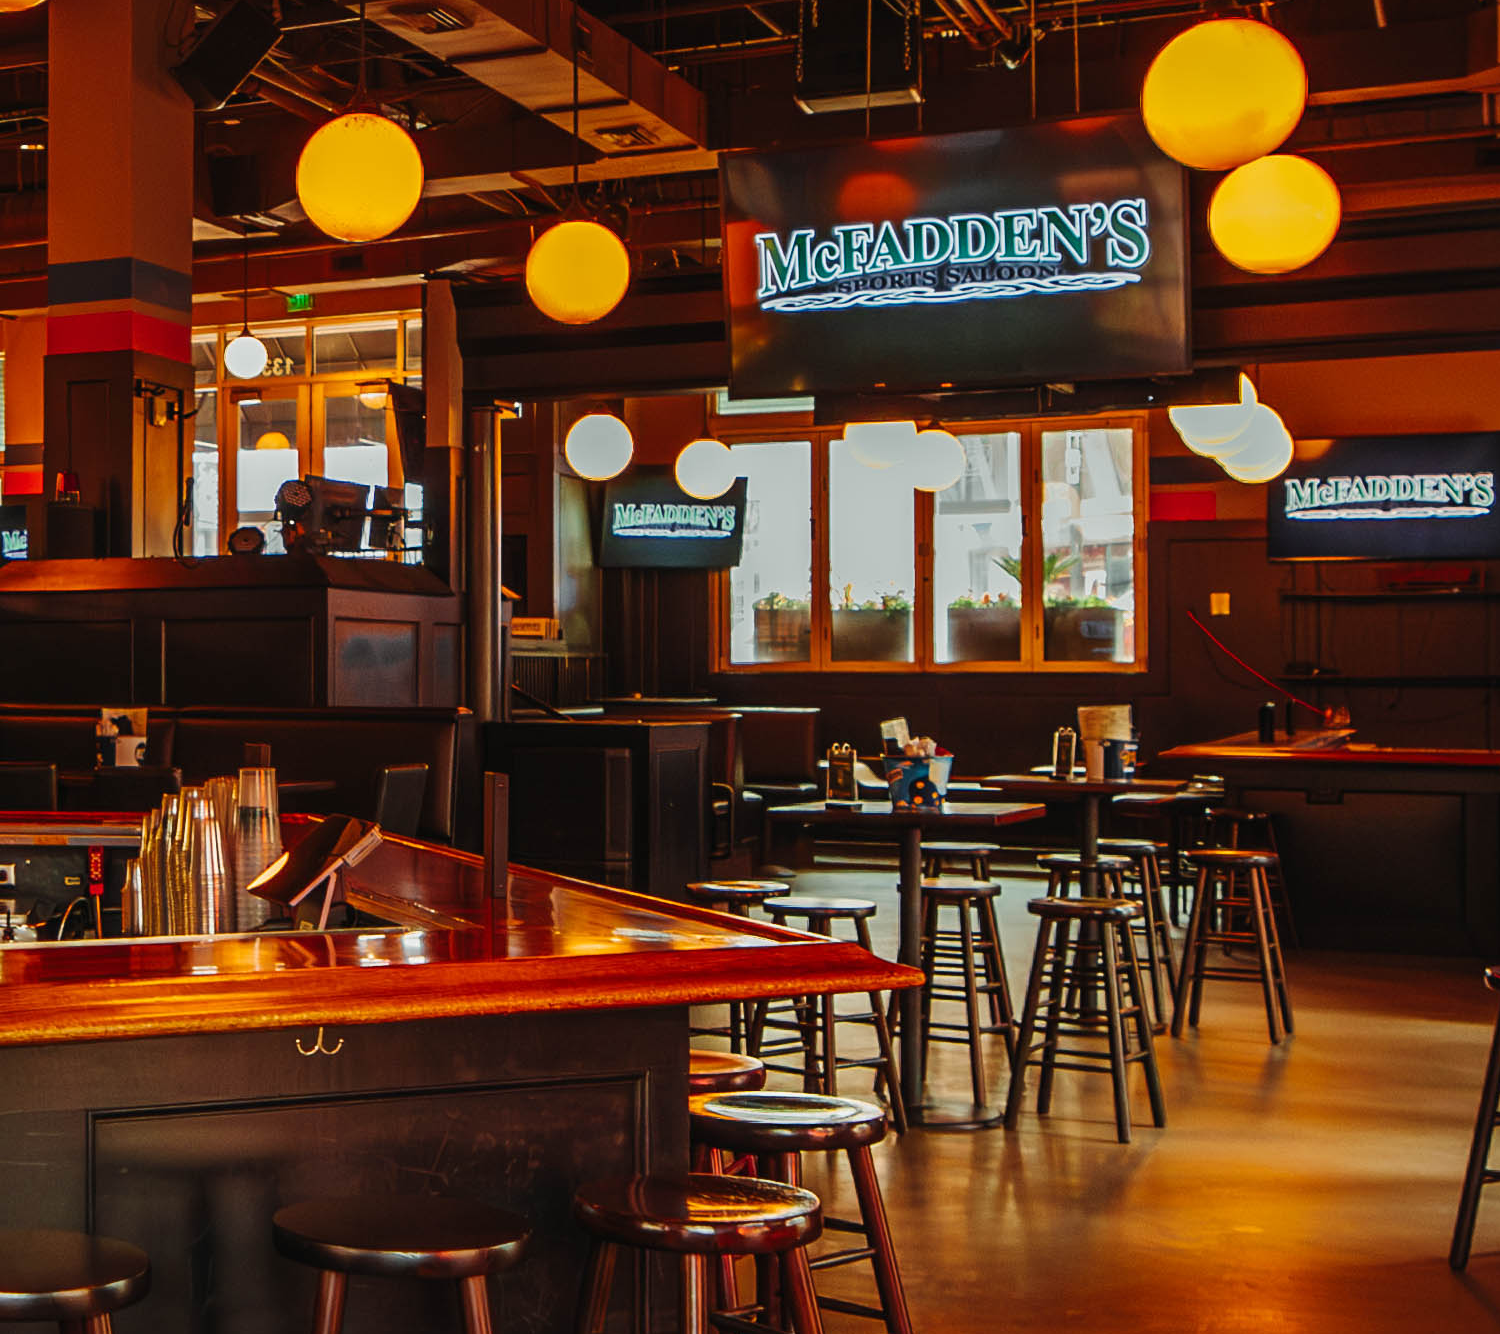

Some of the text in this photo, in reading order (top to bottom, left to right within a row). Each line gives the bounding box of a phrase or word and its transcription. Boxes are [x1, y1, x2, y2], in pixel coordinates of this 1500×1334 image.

[756, 197, 1151, 297] McFADDEN'S
[836, 264, 1060, 293] SPORTS SALOON
[1283, 471, 1496, 513] McFADDEN'S
[612, 502, 736, 531] McFADDEN'S
